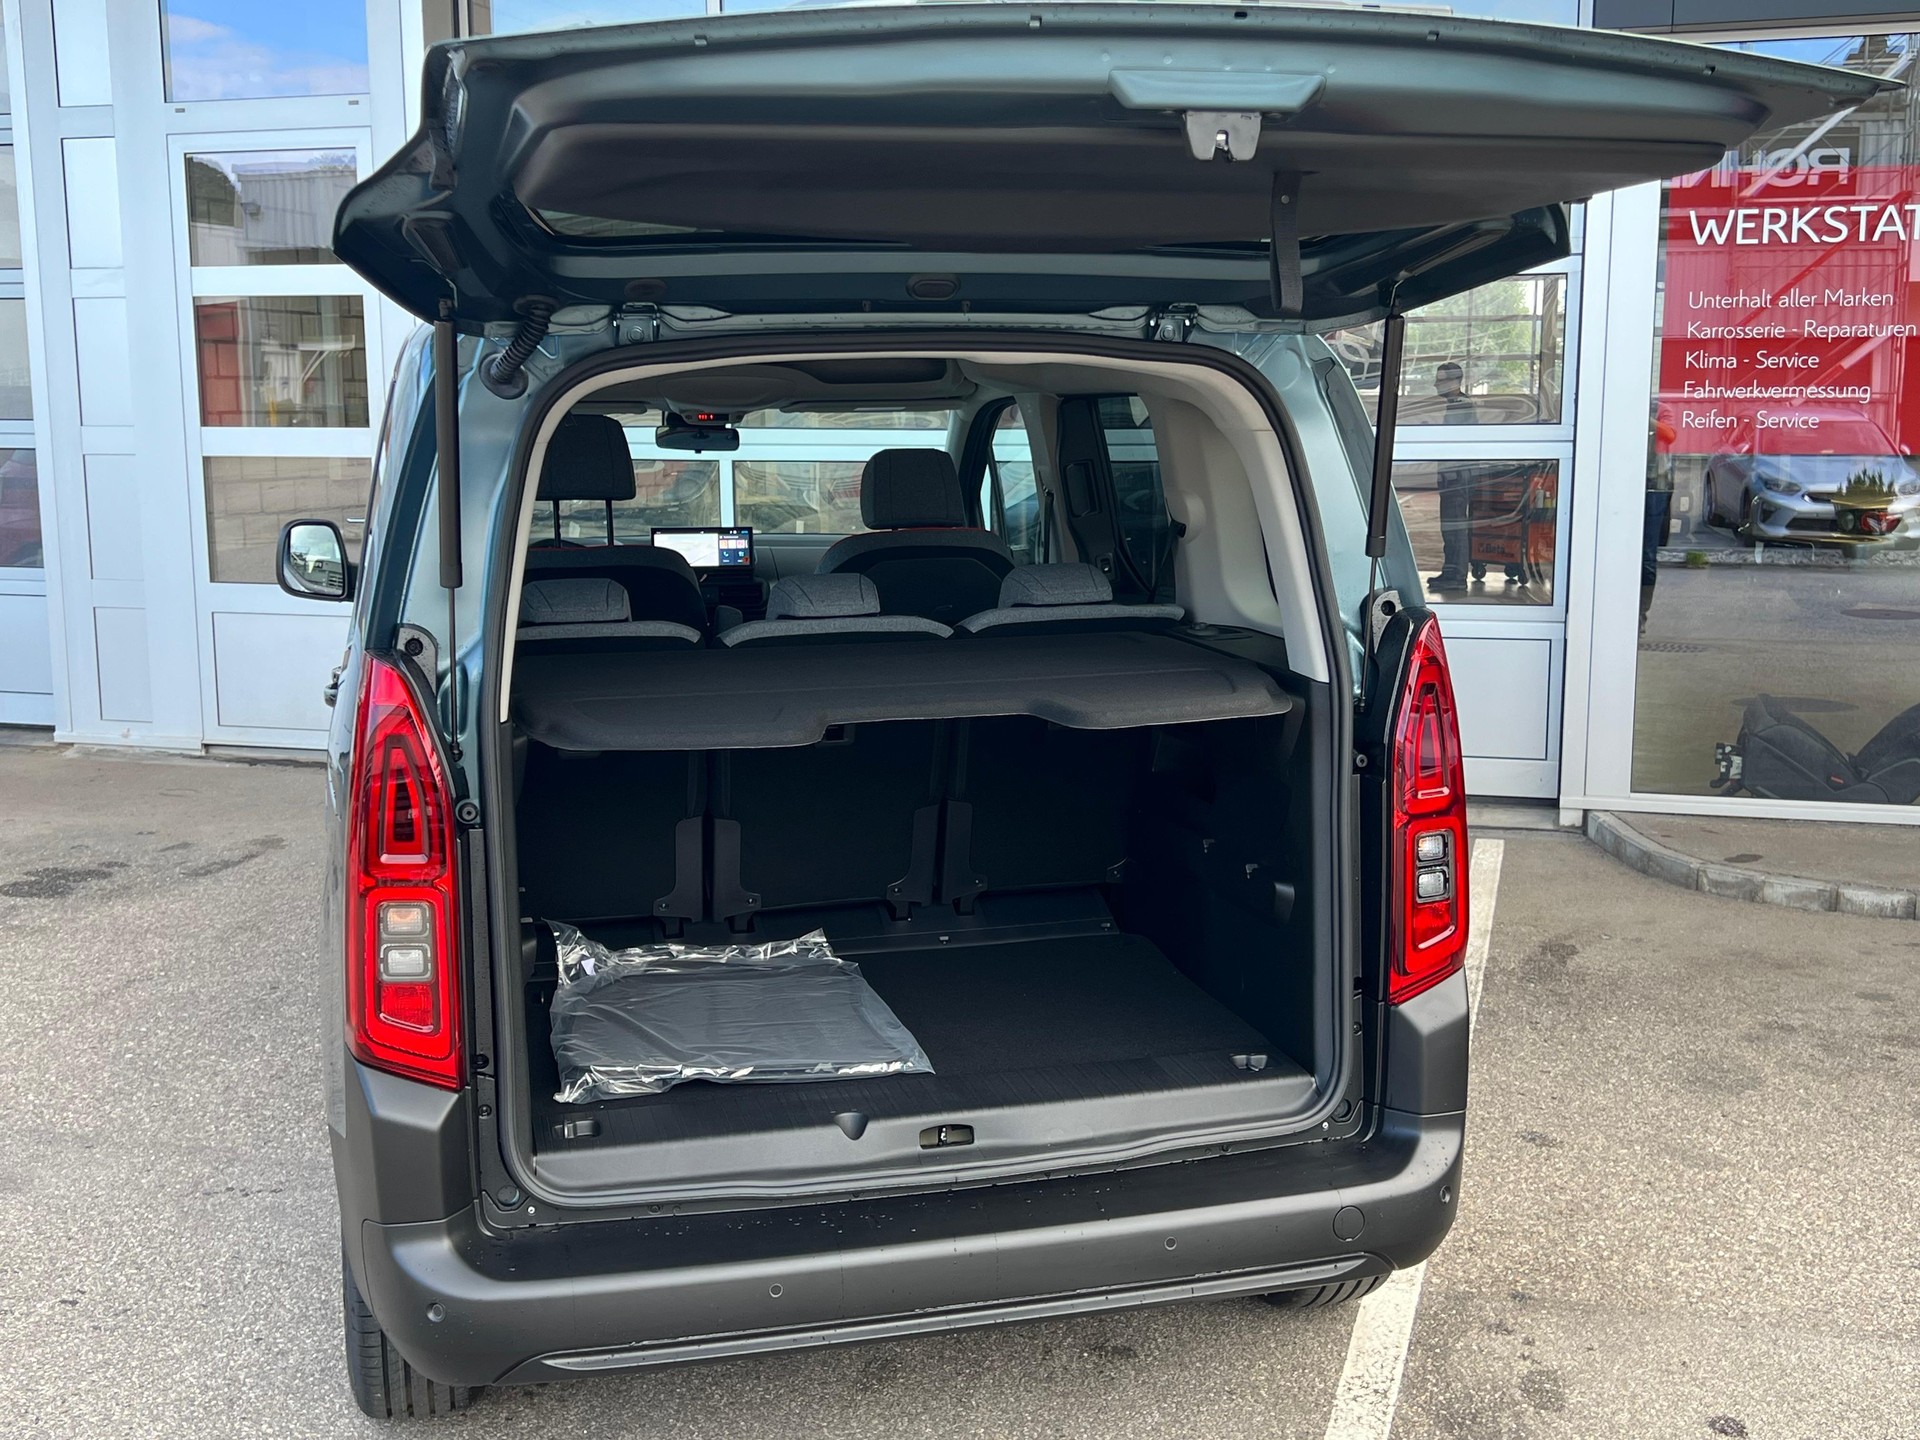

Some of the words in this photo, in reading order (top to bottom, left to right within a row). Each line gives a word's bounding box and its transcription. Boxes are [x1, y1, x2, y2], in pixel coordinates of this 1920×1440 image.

[1689, 204, 1920, 246] WERKSTAT
[1689, 288, 1772, 309] Unterhalt
[1778, 287, 1818, 308] aller
[1824, 286, 1894, 307] Marken
[1687, 320, 1786, 339] Karrosserie
[1804, 319, 1917, 343] Reparaturen
[1685, 350, 1737, 369] Klima
[1755, 350, 1820, 369] Service
[1683, 379, 1871, 404] Fahrwerkvermessung
[1682, 409, 1738, 429] Reifen
[1756, 410, 1820, 429] Service
